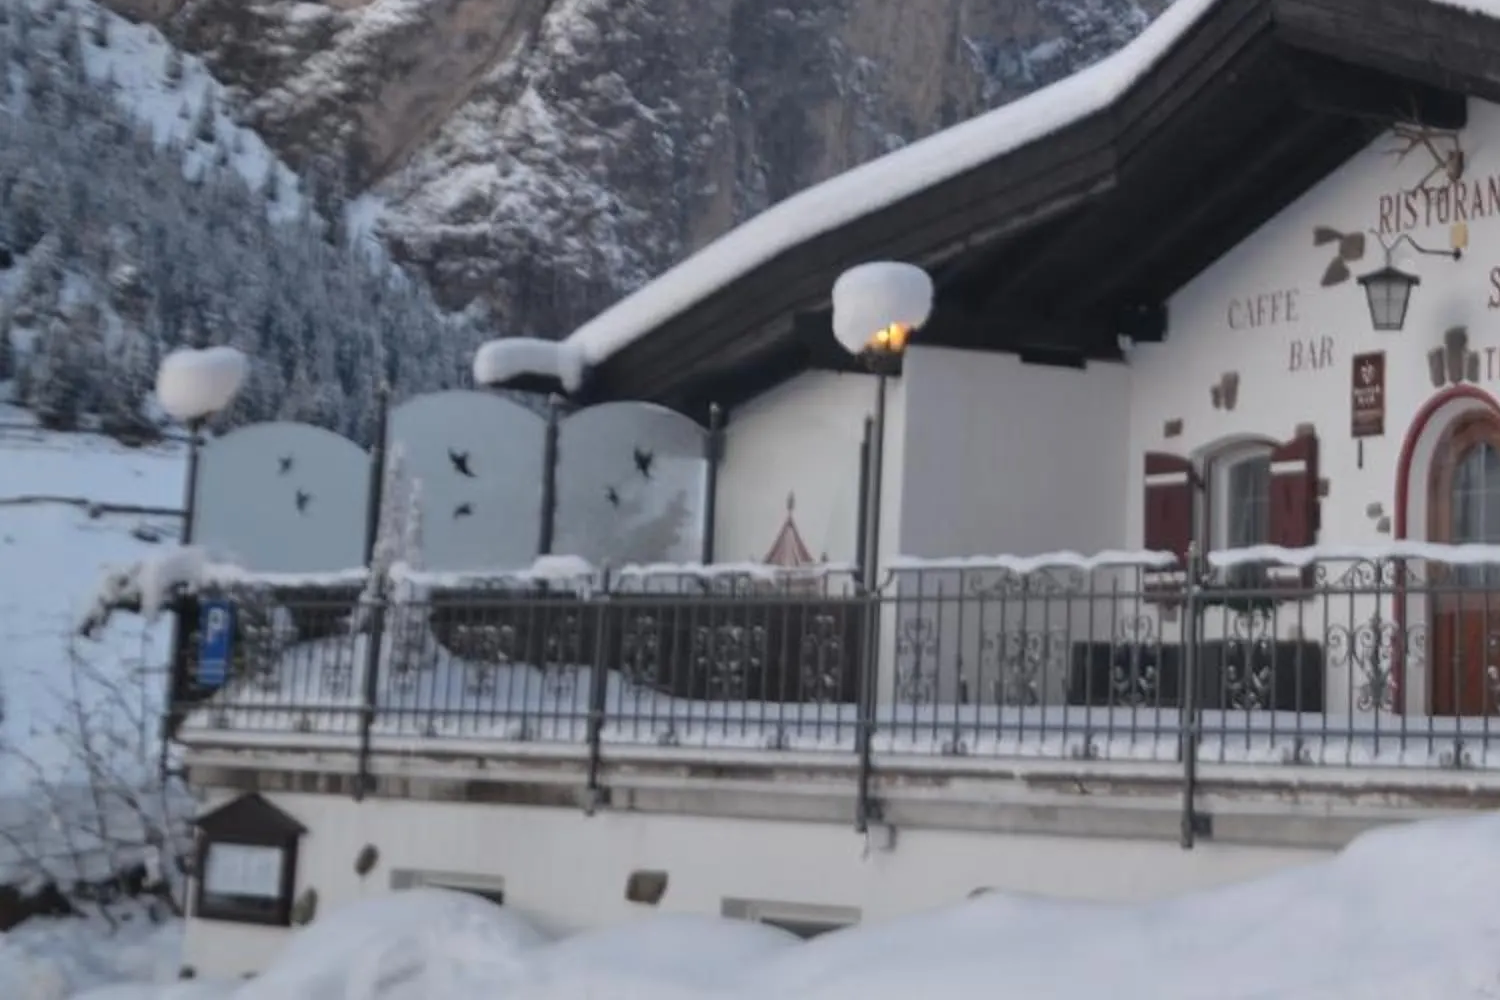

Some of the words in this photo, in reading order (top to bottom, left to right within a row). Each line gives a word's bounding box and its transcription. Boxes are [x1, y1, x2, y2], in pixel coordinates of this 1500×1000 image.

[1227, 288, 1300, 329] CAFFE
[1288, 335, 1335, 371] BAR
[207, 606, 226, 642] P
